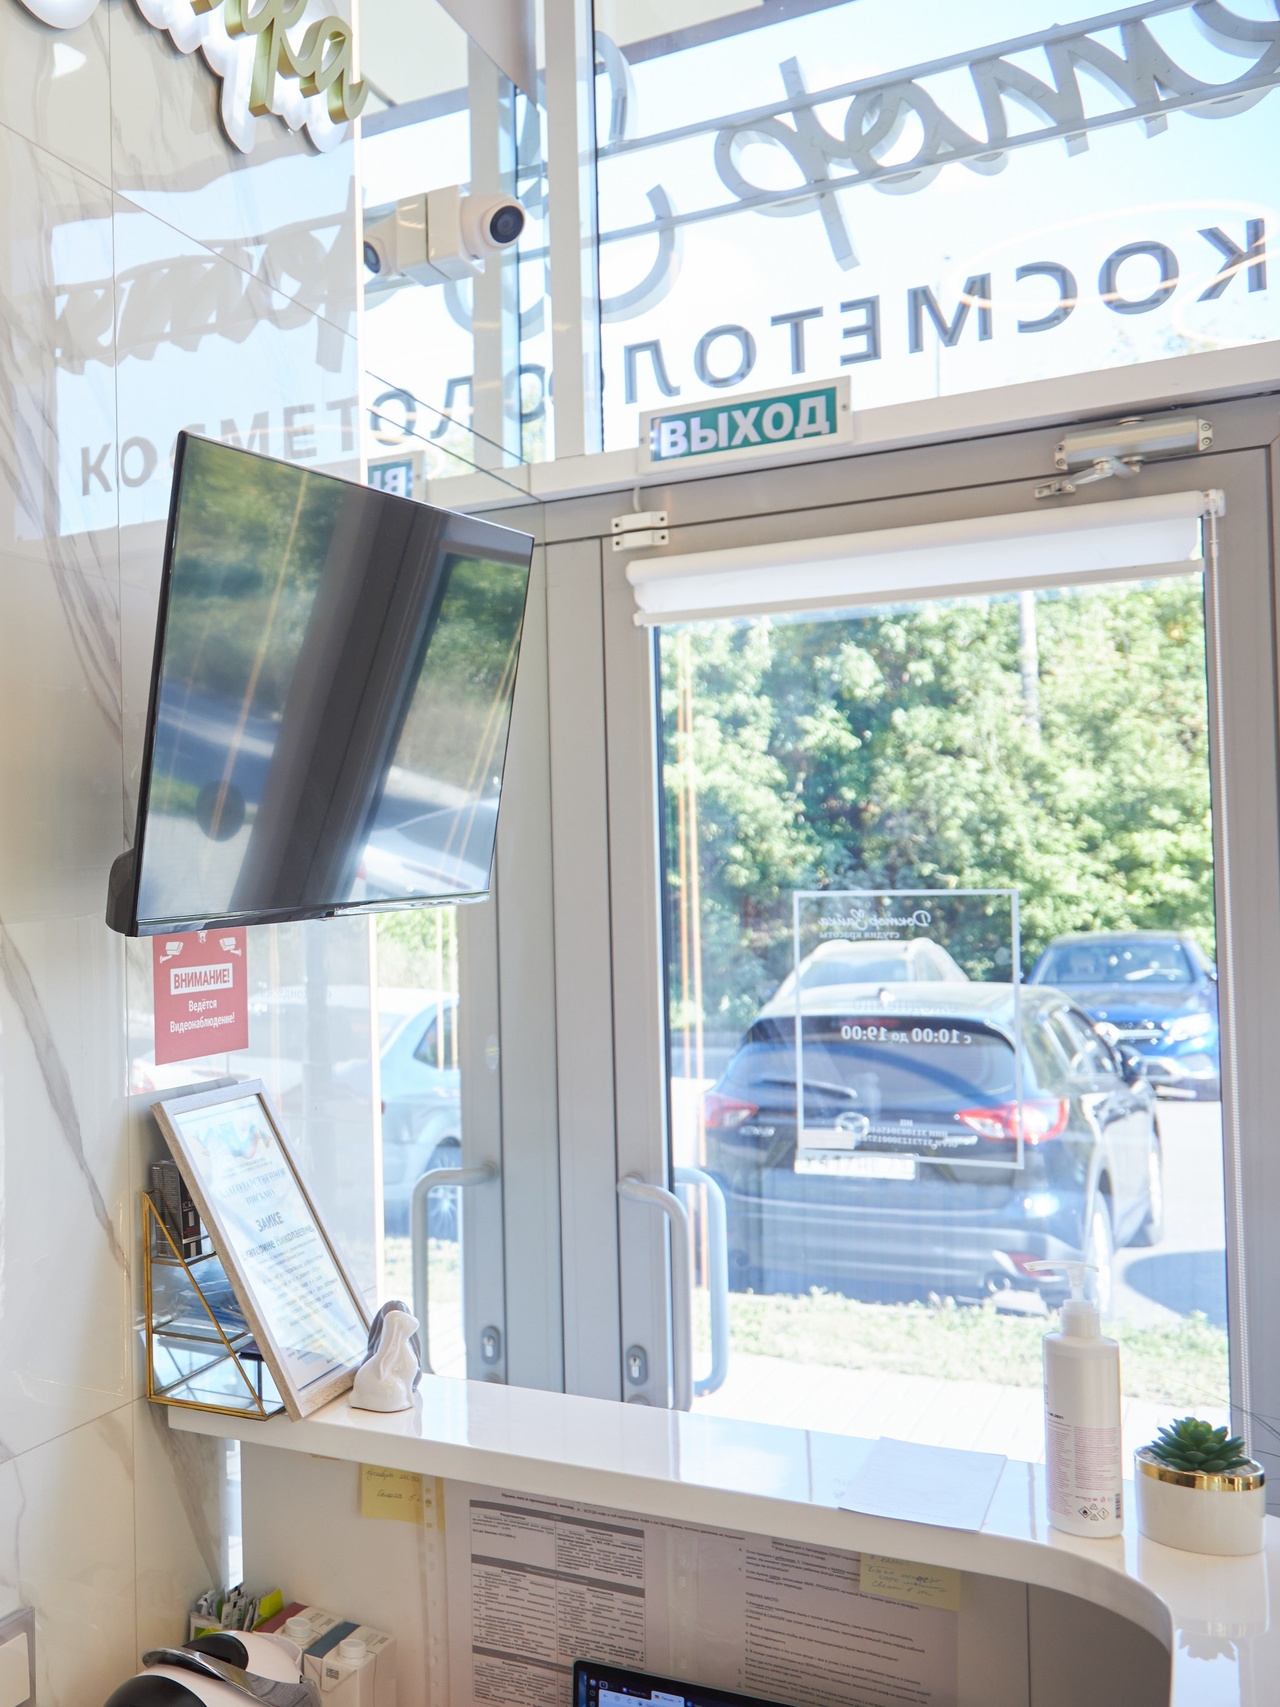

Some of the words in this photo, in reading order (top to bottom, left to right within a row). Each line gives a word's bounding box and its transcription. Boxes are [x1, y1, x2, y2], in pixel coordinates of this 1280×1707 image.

[657, 395, 832, 459] ВЫХОД
[173, 967, 231, 988] ВНИМАНИЕ!
[188, 997, 218, 1014] Ведётся
[169, 1011, 236, 1034] Видеонаблюдение!
